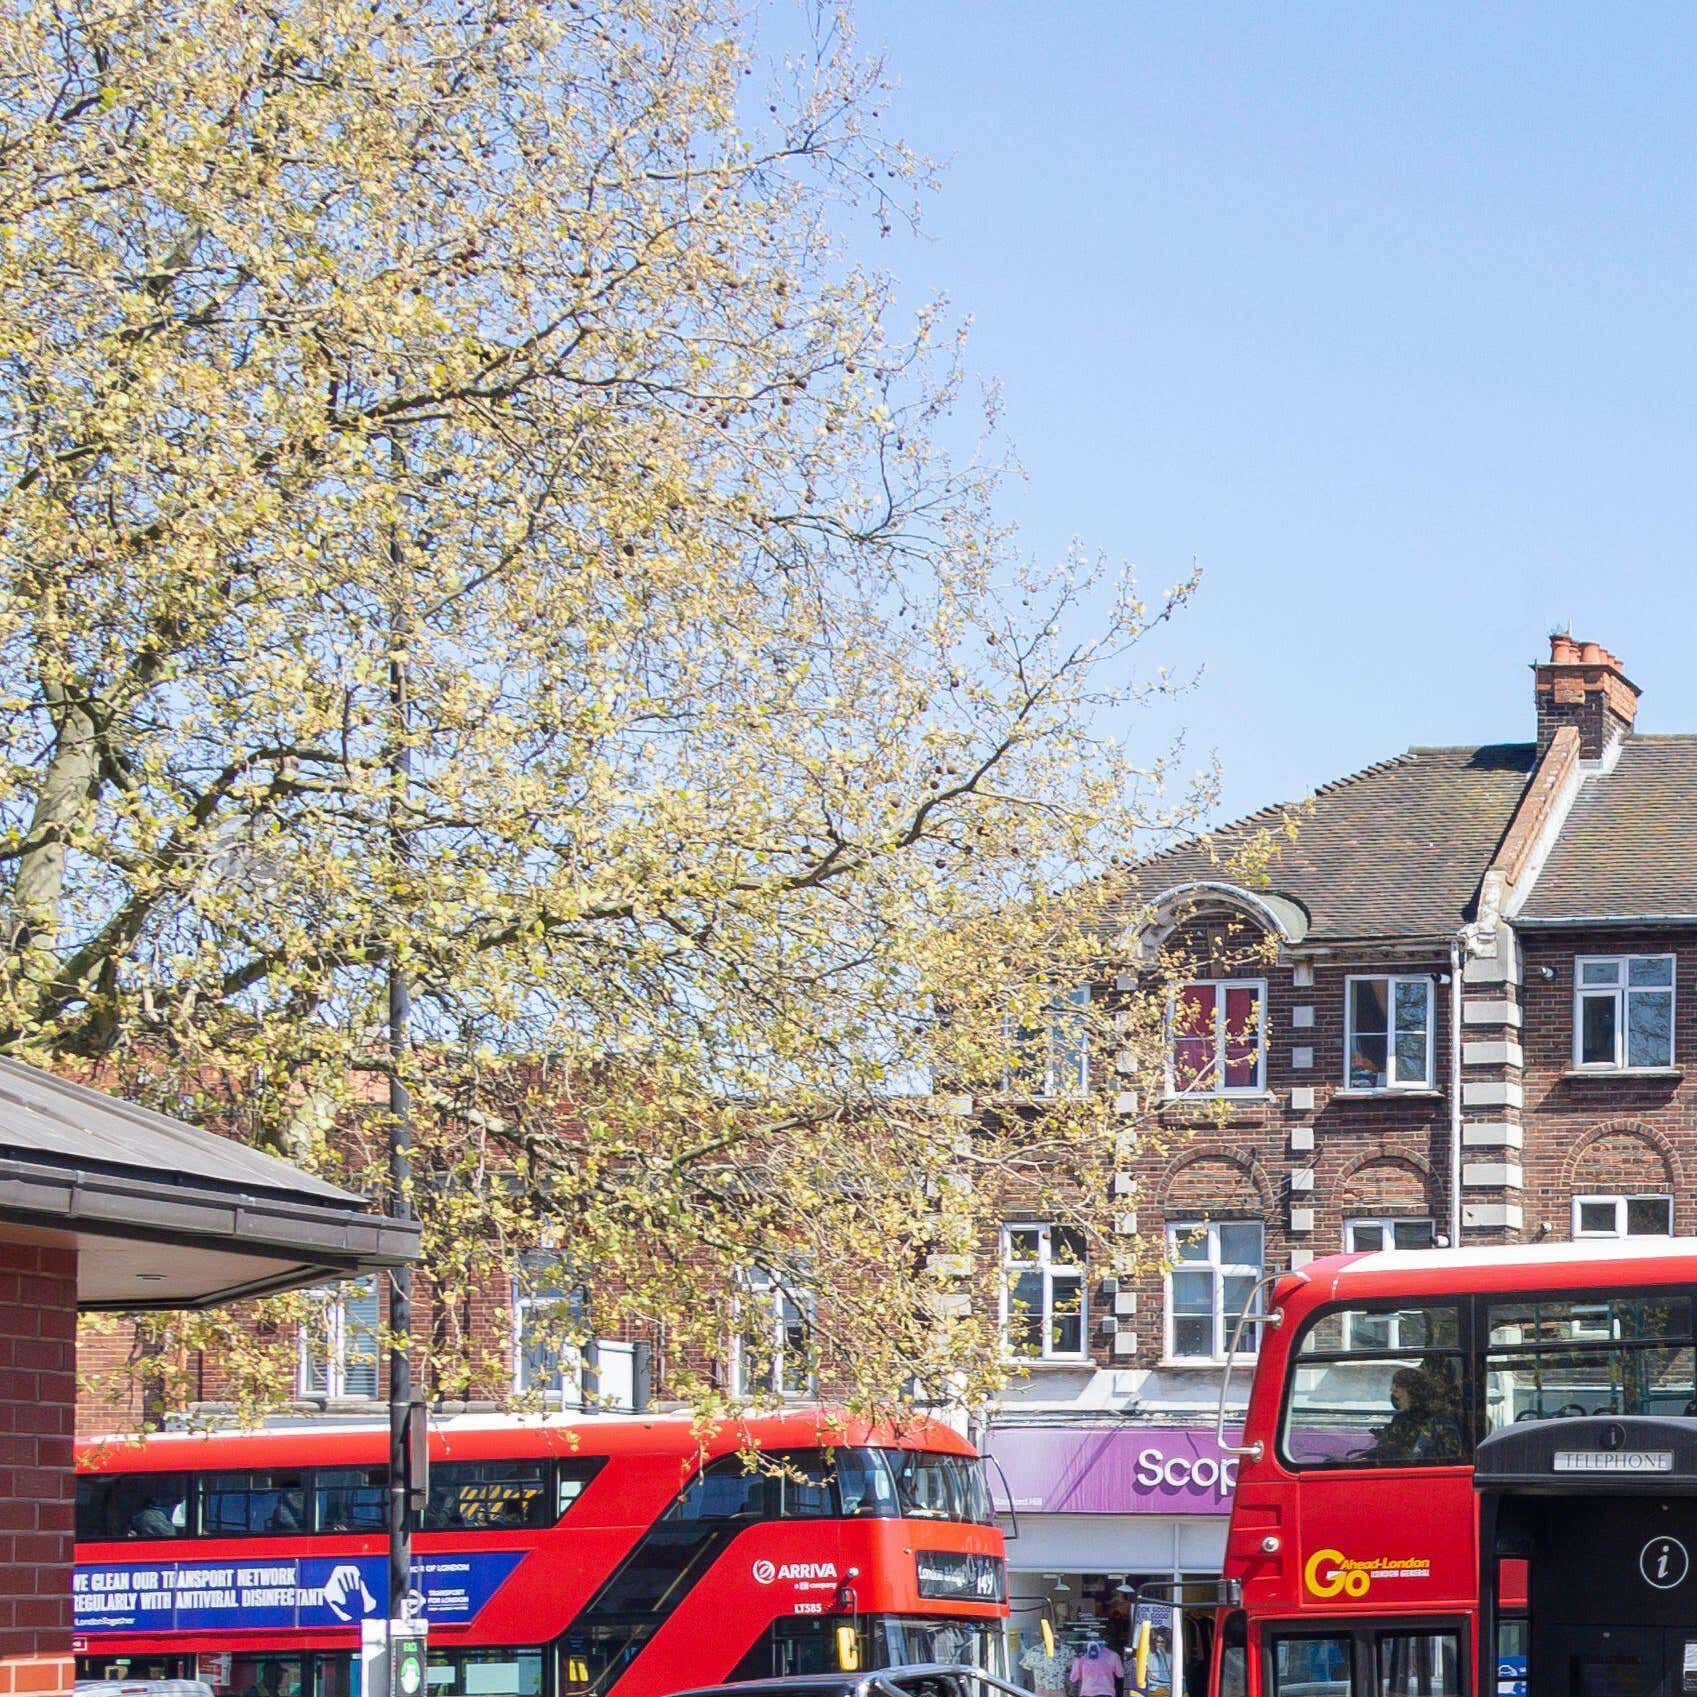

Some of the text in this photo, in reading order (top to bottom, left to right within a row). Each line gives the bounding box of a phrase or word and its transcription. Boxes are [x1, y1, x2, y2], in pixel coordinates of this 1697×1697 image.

[1565, 1453, 1667, 1469] TELEPHONE
[778, 1562, 838, 1579] ARRIVA
[1304, 1548, 1370, 1598] Go
[1340, 1557, 1430, 1570] Ahead-London
[91, 1572, 129, 1591] CLEAN
[132, 1571, 158, 1589] OUR
[161, 1568, 233, 1589] TRANSPORT
[237, 1567, 296, 1587] NETWORK
[140, 1591, 171, 1610] WITH
[175, 1589, 238, 1609] ANTIVIRAL
[241, 1588, 325, 1608] DISINFECTANT
